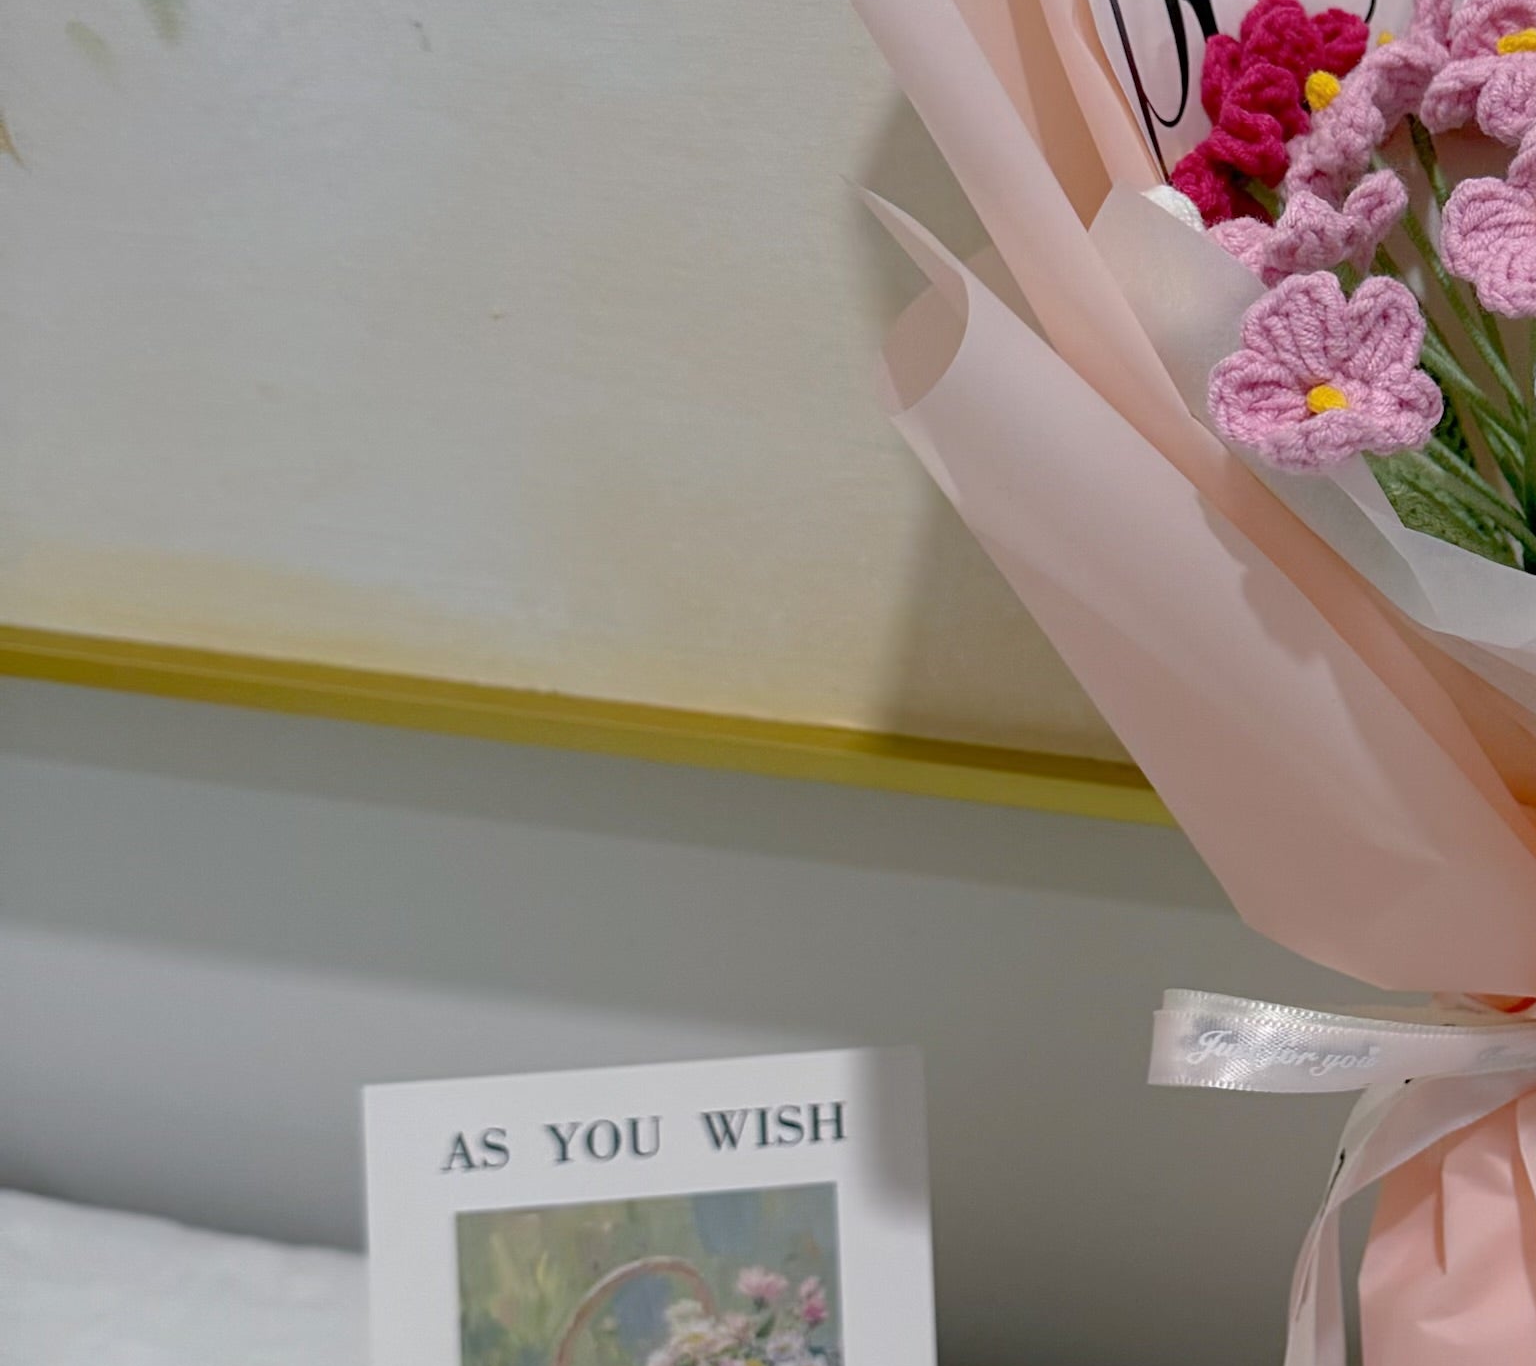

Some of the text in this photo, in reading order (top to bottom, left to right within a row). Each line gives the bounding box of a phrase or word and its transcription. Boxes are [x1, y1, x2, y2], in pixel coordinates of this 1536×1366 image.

[440, 1100, 848, 1173] AS YOU WISH
